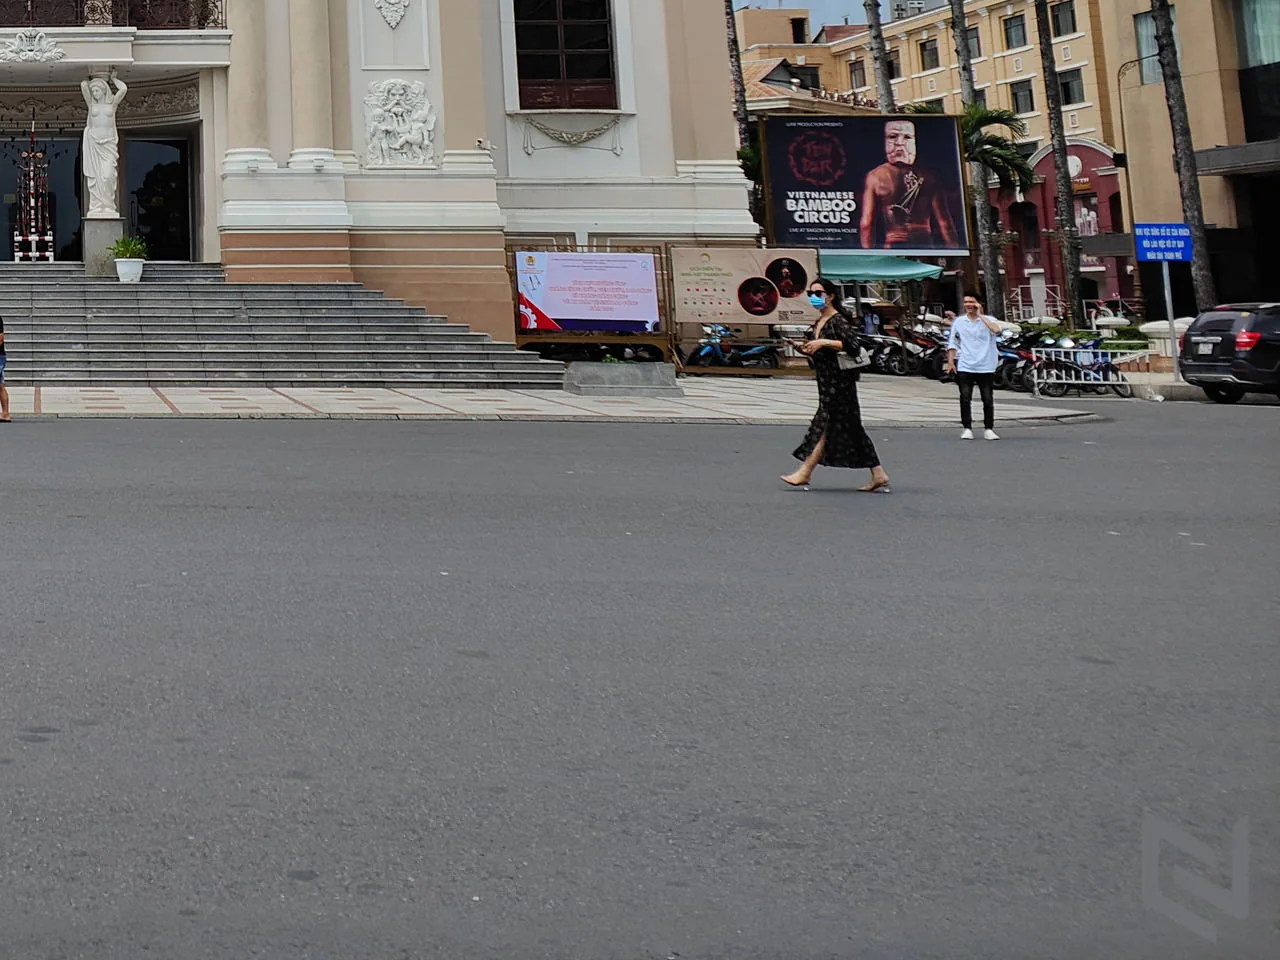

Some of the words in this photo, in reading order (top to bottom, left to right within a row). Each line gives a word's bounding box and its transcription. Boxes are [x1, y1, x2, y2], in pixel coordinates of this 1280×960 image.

[787, 191, 855, 199] VIETNAMESE
[785, 199, 857, 212] BAMBOO
[793, 211, 851, 224] CIRCUS
